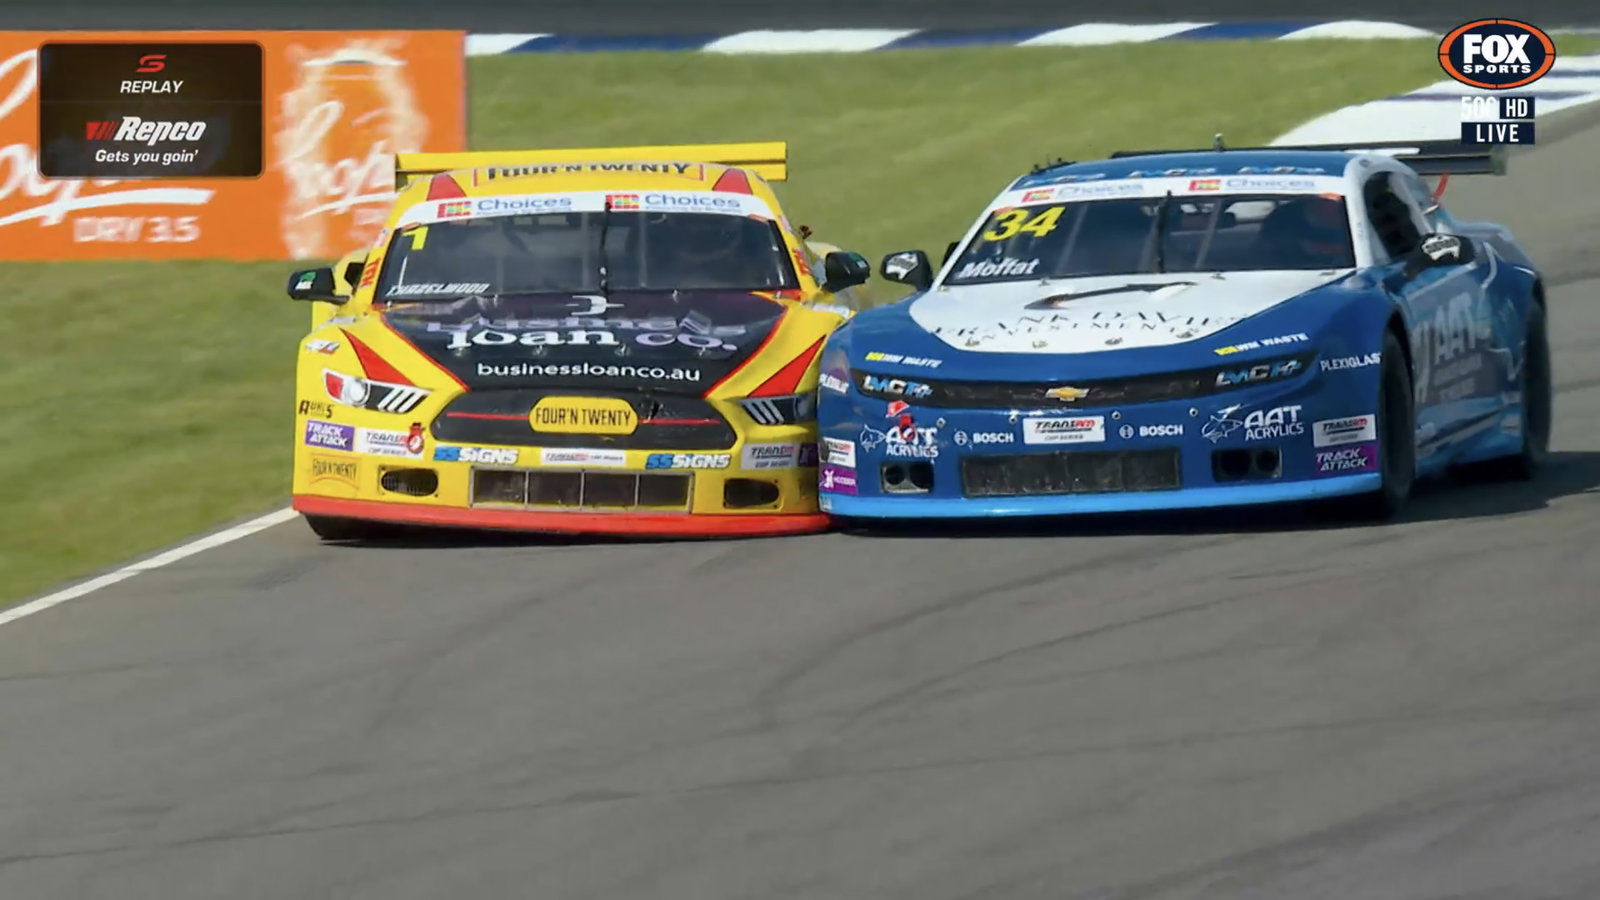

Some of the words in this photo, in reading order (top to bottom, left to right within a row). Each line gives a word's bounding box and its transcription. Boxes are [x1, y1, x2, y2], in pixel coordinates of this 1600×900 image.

[1057, 182, 1144, 197] Choices
[1226, 178, 1316, 189] Choices
[477, 197, 573, 212] Choices
[645, 193, 741, 209] Choices
[983, 206, 1066, 241] 34
[402, 226, 428, 250] 1
[957, 258, 1040, 278] Moffat
[477, 362, 700, 381] businessloanco.au
[535, 408, 579, 424] FOUR'N
[582, 409, 631, 427] TWENTY
[1244, 405, 1302, 429] AAT
[307, 422, 343, 437] TRACK
[1140, 425, 1183, 437] BOSCH
[1245, 423, 1304, 441] ACRYLICS
[309, 433, 350, 448] ATTACK
[973, 432, 1014, 443] BOSCH
[886, 445, 939, 458] ACRYLICS
[1316, 448, 1361, 463] TRACK
[1320, 456, 1368, 471] ATTACK
